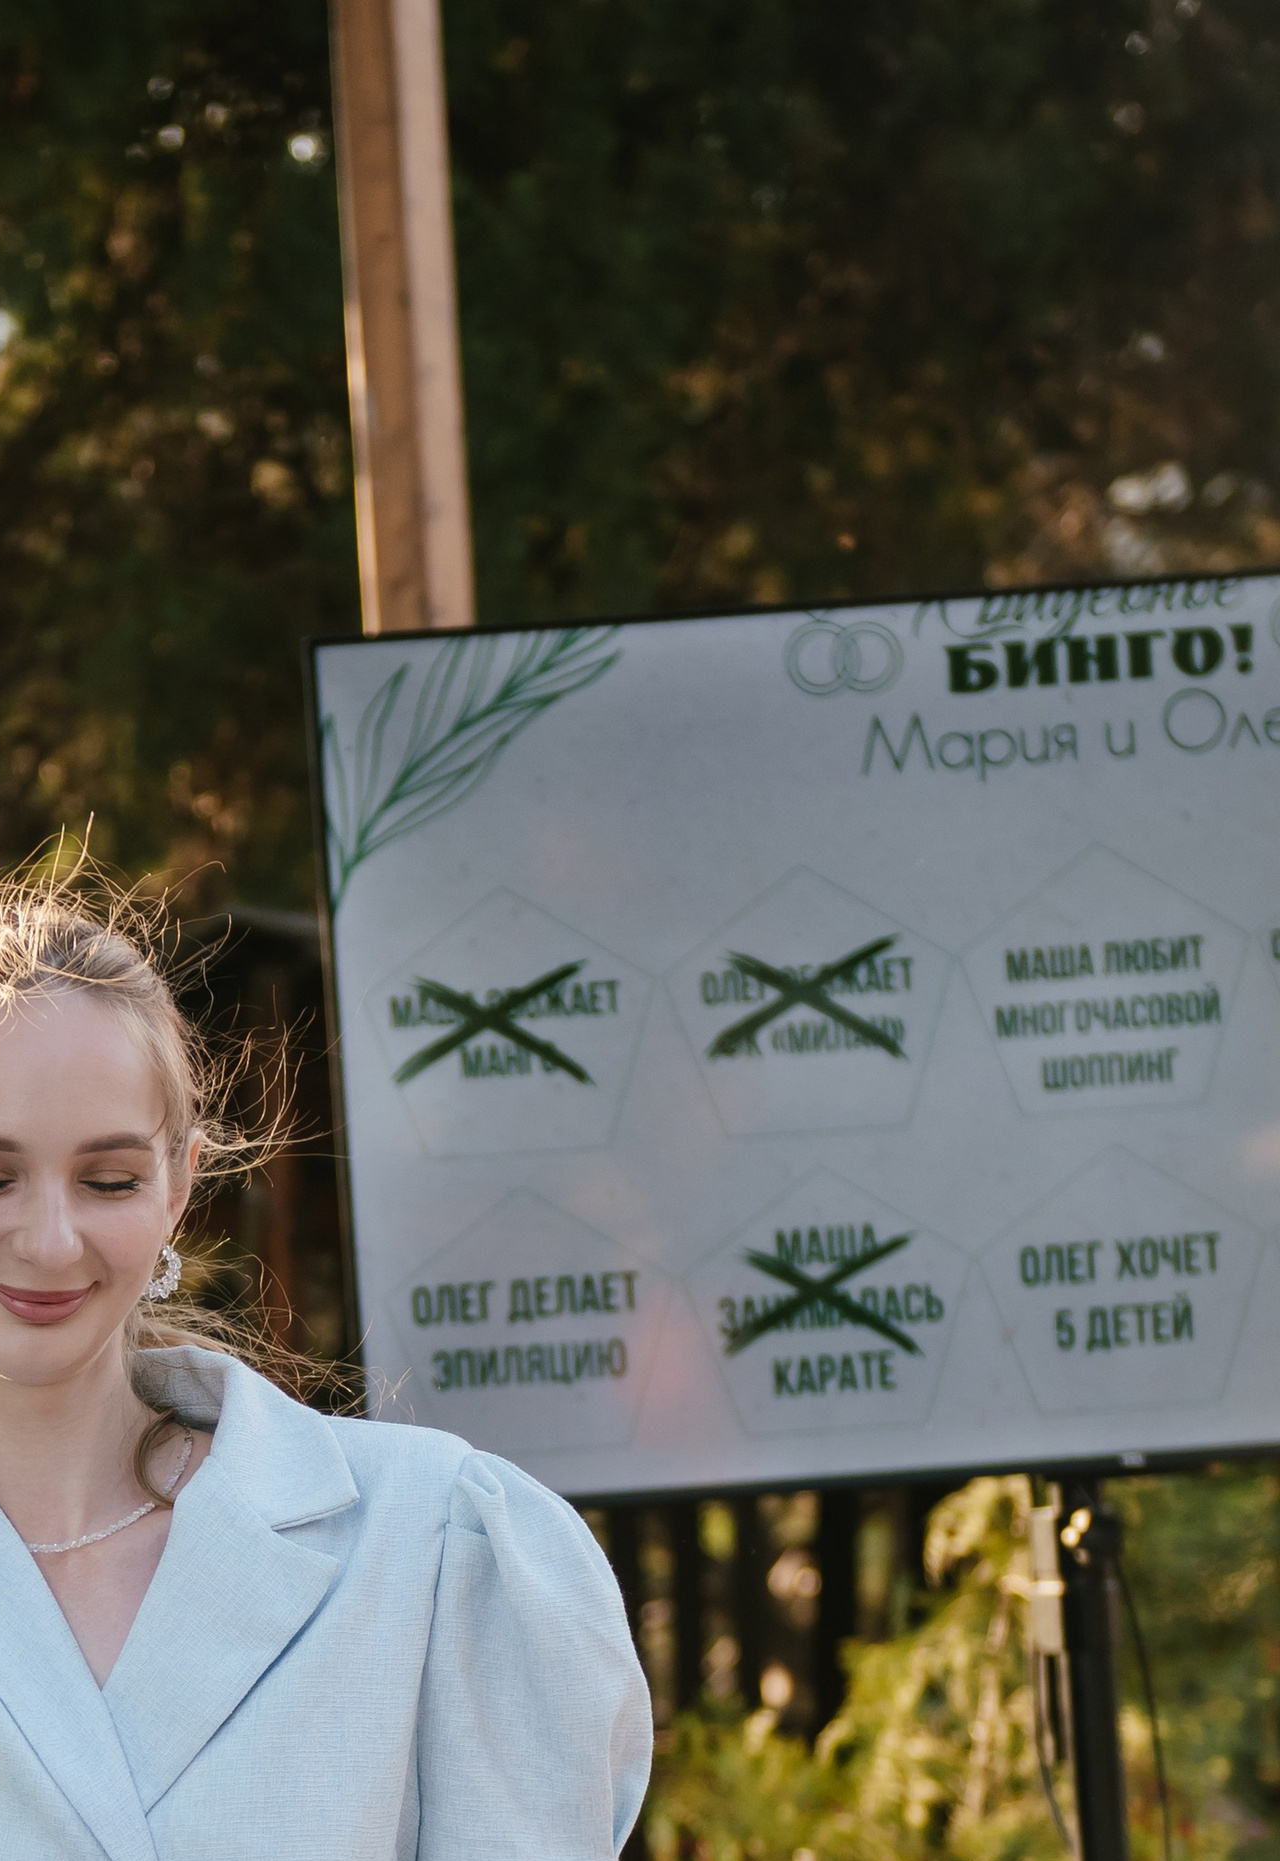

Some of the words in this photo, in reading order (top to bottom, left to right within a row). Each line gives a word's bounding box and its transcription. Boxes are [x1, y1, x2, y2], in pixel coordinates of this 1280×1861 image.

[944, 622, 1254, 694] БИНГО!
[859, 711, 1079, 783] Мария
[1104, 719, 1136, 760] и
[1006, 944, 1094, 983] МАША
[1104, 934, 1204, 976] ЛЮБИТ
[995, 981, 1221, 1038] МНОГОЧАСОВОЙ
[1041, 1047, 1179, 1092] ШОППИНГ
[1020, 1240, 1102, 1287] ОЛЕГ
[1115, 1231, 1219, 1280] ХОЧЕТ
[412, 1280, 495, 1327] ОЛЕГ
[508, 1271, 637, 1324] ДЕЛАЕТ
[1055, 1308, 1076, 1350] 5
[1086, 1291, 1194, 1352] ДЕТЕЙ
[432, 1338, 629, 1391] ЭПИЛЯЦИЮ
[774, 1349, 897, 1396] КАРАТЕ
